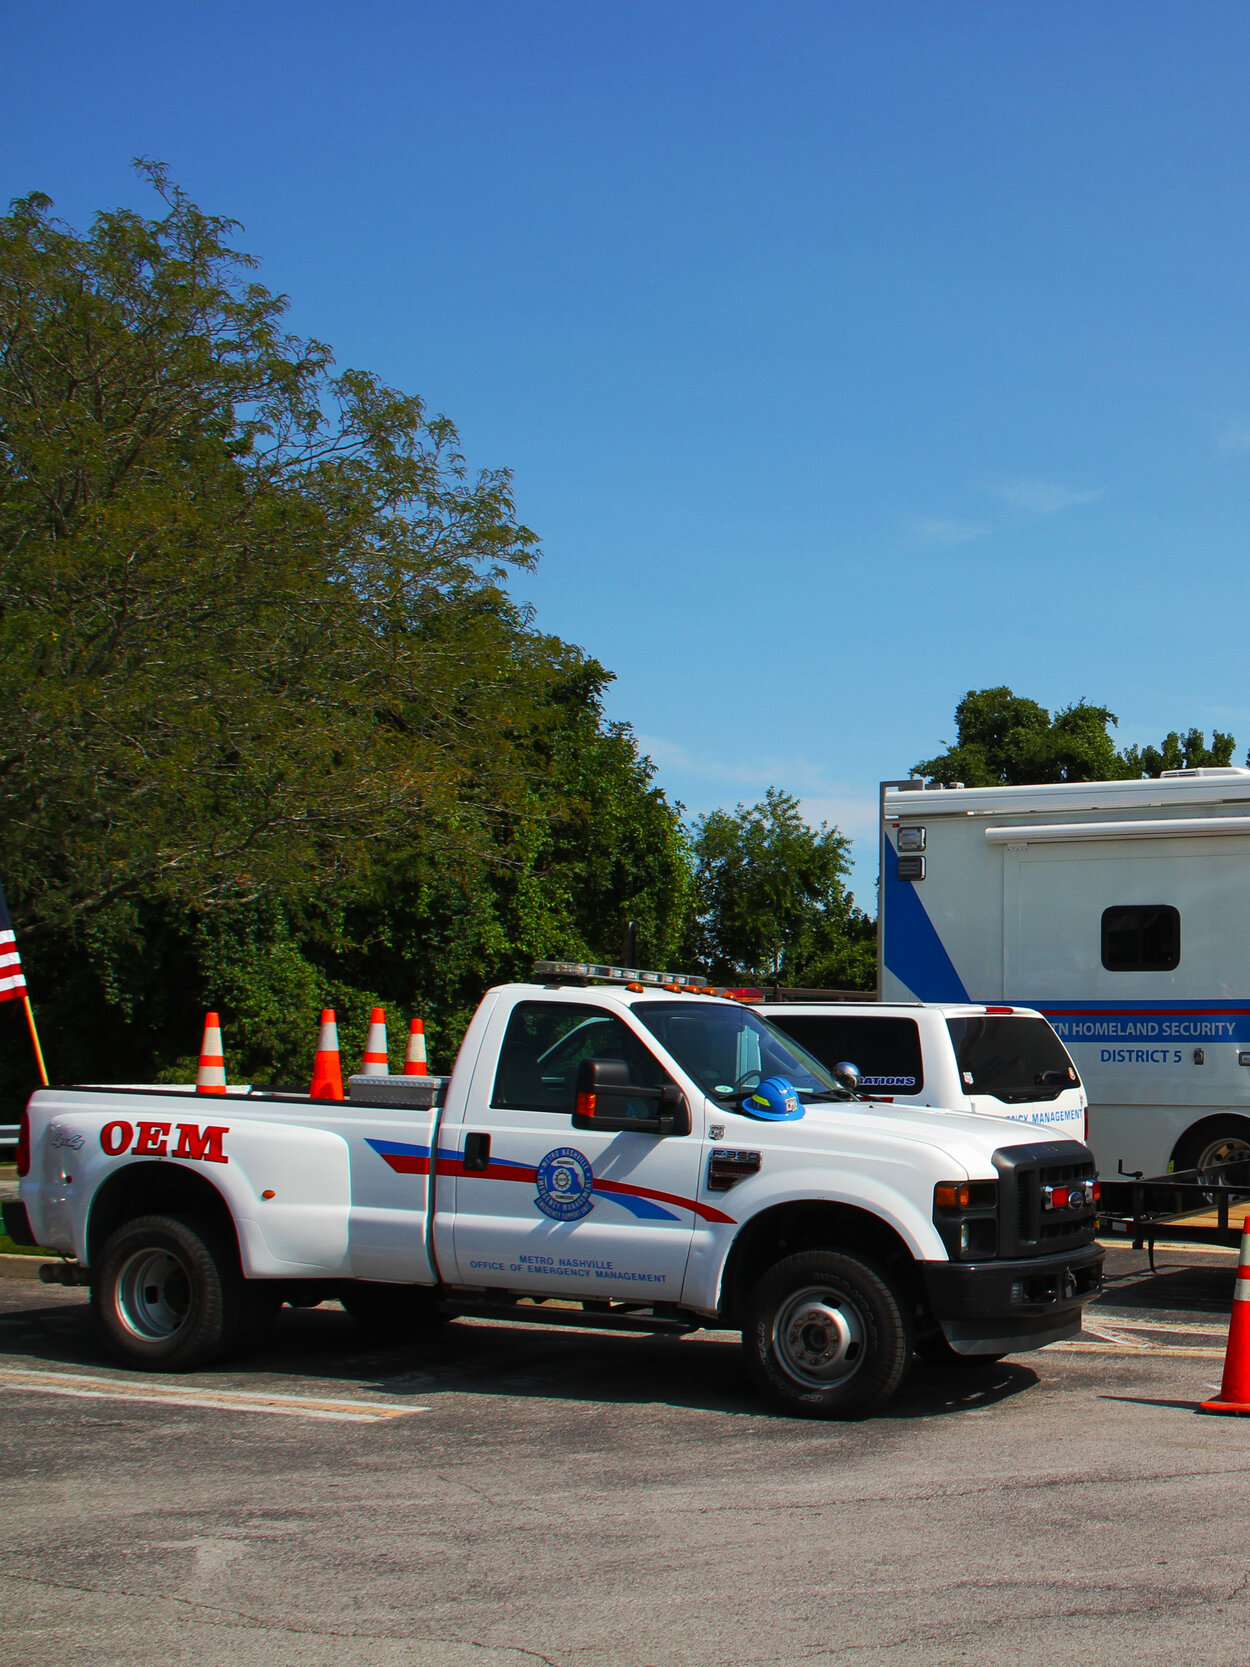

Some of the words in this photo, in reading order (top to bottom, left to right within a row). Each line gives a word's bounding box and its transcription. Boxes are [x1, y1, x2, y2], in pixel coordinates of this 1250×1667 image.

[1073, 1022, 1159, 1036] HOMELAND
[1162, 1022, 1236, 1036] SECURITY
[1101, 1050, 1170, 1063] DISTRICT
[1173, 1050, 1182, 1063] 5
[1031, 1109, 1083, 1123] MANAGEMENT
[101, 1120, 230, 1164] OEM
[519, 1255, 554, 1265] METRO
[559, 1258, 613, 1270] NASHVILLE
[470, 1260, 505, 1271] OFFICE
[510, 1263, 522, 1272] OF
[528, 1264, 590, 1278] EMERGENCY
[595, 1270, 667, 1283] MANAGEMENT
